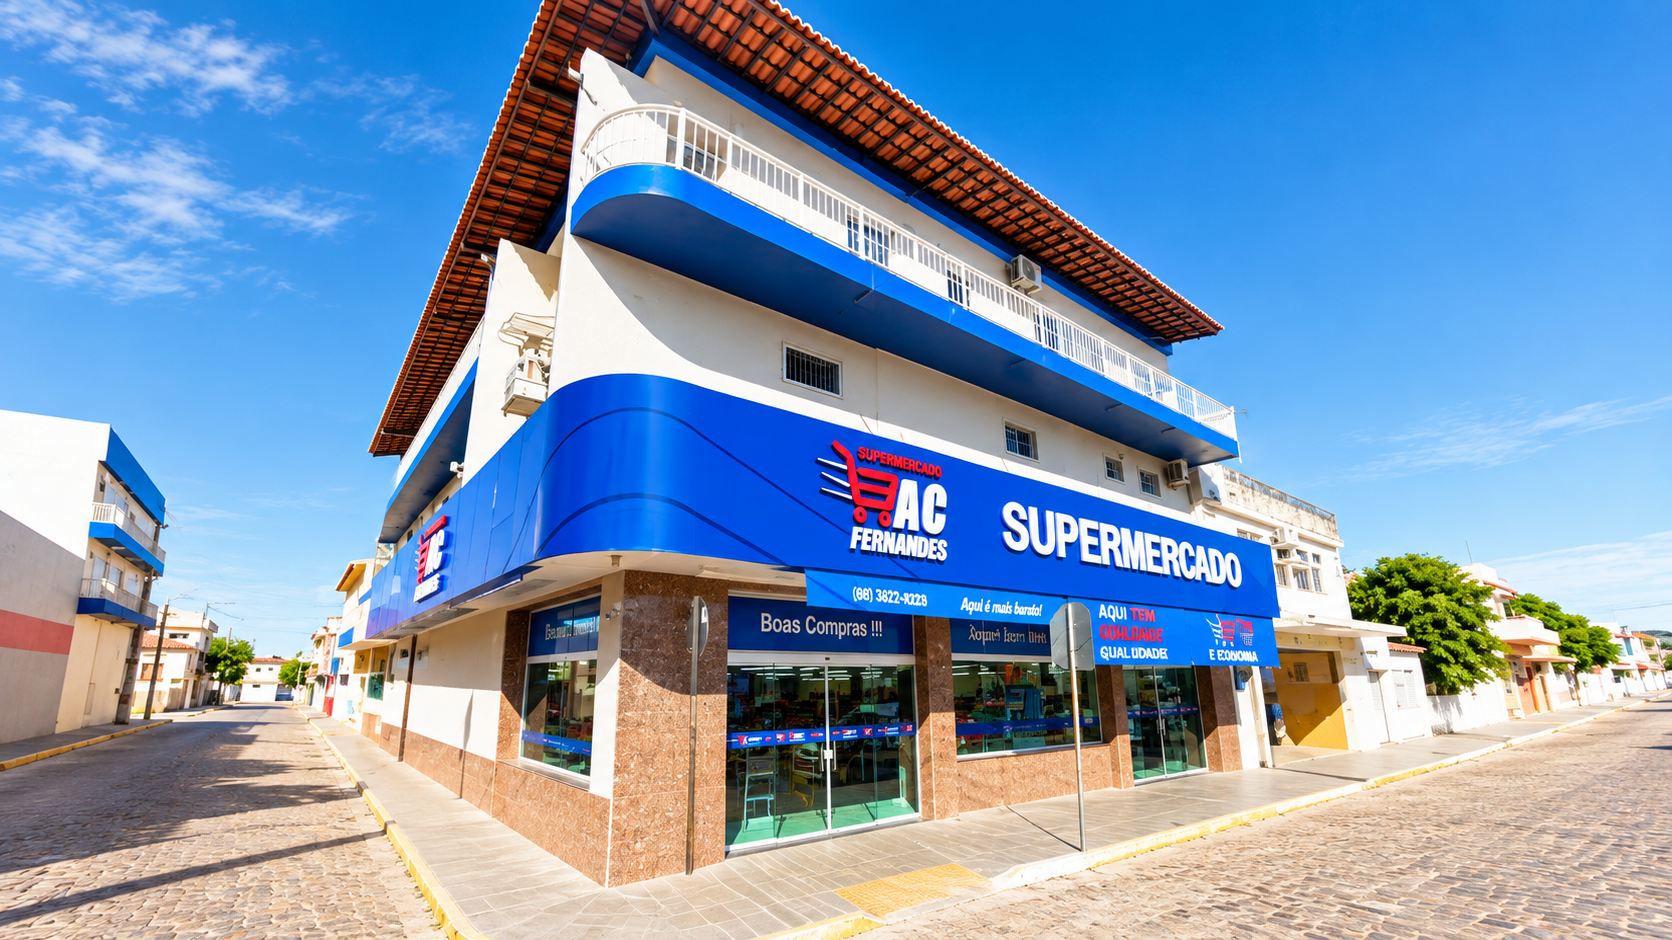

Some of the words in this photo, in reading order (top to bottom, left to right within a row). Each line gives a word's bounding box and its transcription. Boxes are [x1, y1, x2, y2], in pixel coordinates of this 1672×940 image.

[857, 446, 943, 478] SUPERMERCADO
[892, 478, 948, 535] AC
[849, 526, 948, 562] FERNANDES
[1001, 501, 1243, 589] SUPERMERCADO
[984, 599, 992, 613] é
[991, 601, 1013, 615] mais
[1098, 603, 1127, 623] AQUI
[1129, 607, 1156, 622] TEM
[760, 612, 801, 634] Boas
[805, 615, 867, 640] Compras
[871, 620, 883, 637] !!!
[1208, 648, 1216, 661] E
